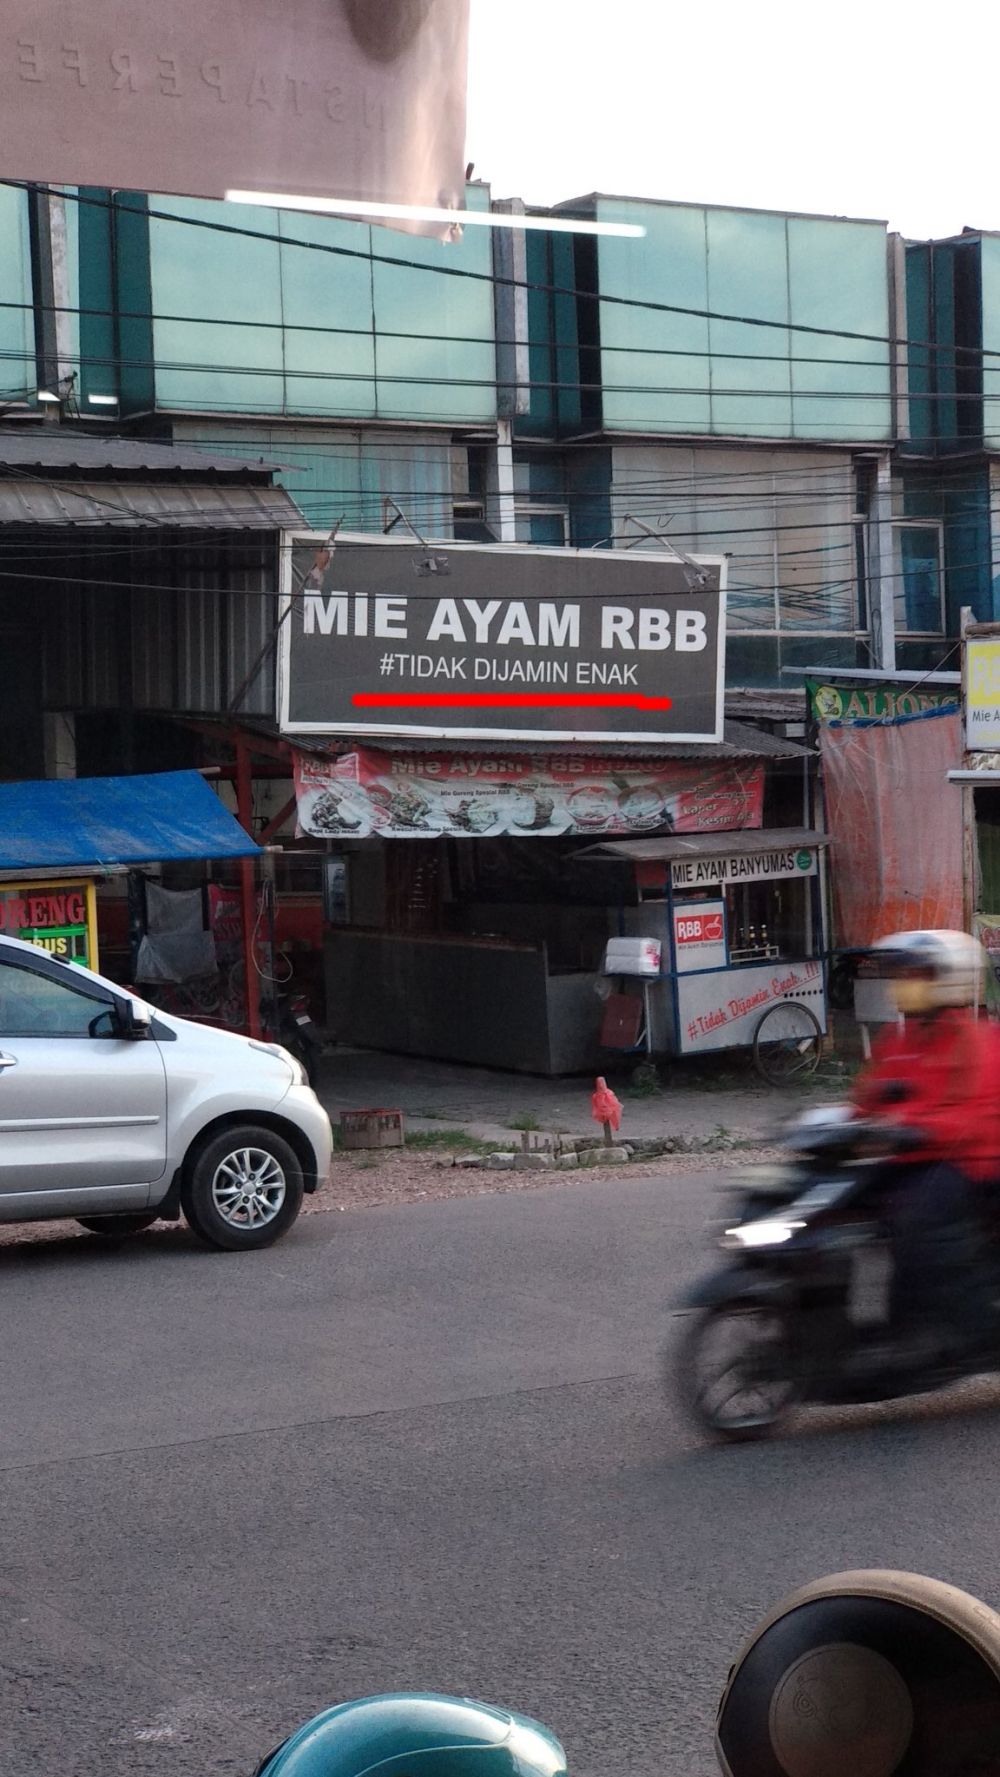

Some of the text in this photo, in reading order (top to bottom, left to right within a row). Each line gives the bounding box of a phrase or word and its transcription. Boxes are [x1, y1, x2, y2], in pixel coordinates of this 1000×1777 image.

[303, 589, 708, 653] MIE AYAM RBB
[380, 652, 639, 687] #TIDAK DIJAMIN ENAK
[972, 710, 991, 722] Mie
[391, 758, 442, 775] Mie
[449, 756, 523, 777] Ayam
[672, 863, 693, 884] MIE
[695, 860, 727, 882] AYAM
[730, 852, 795, 877] BANYUMAS
[677, 920, 702, 940] RBB
